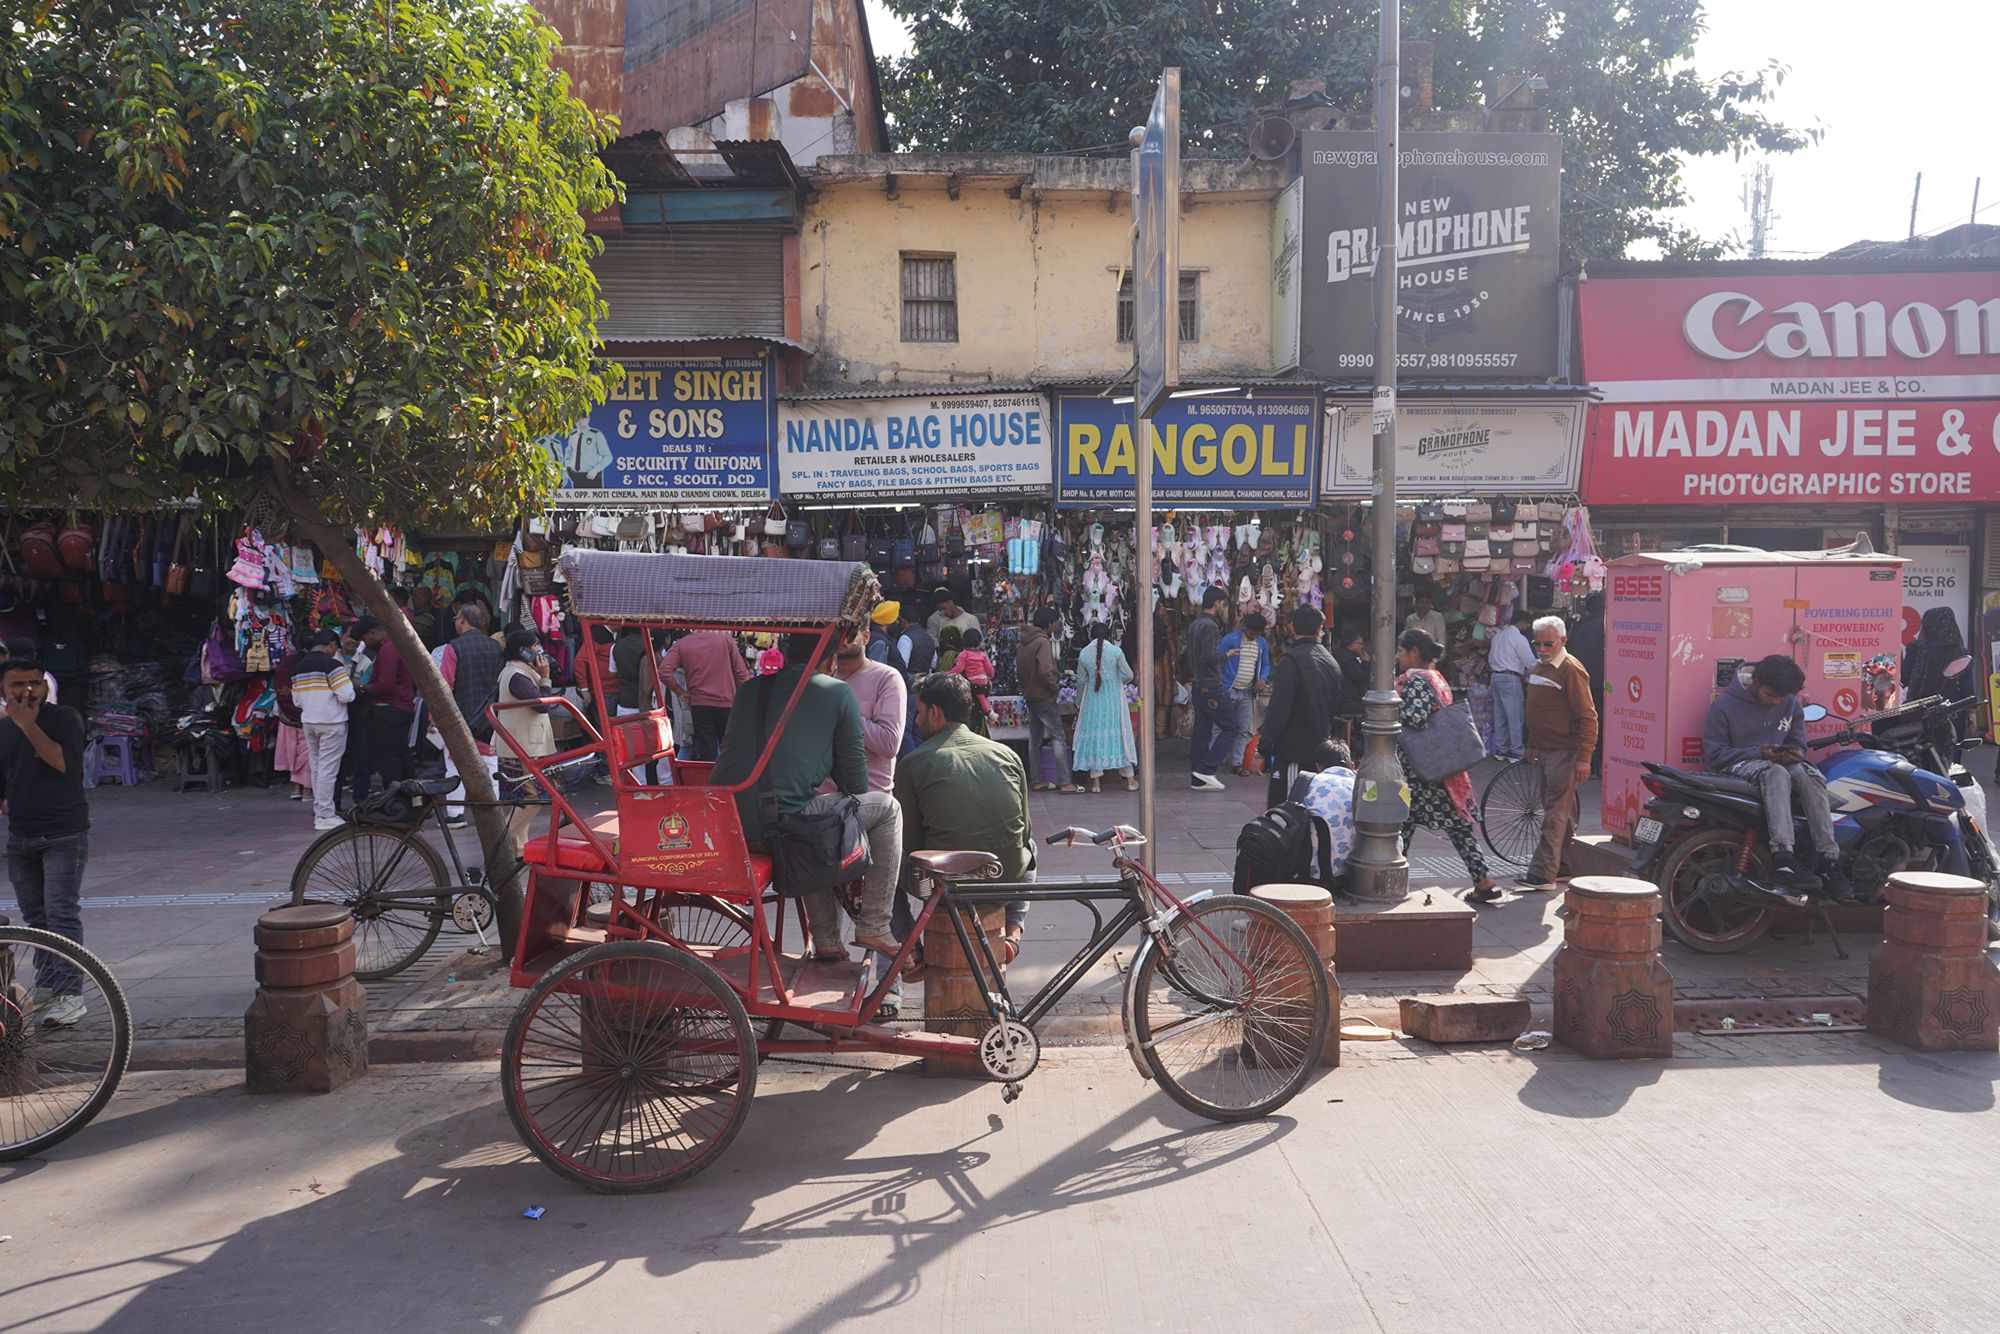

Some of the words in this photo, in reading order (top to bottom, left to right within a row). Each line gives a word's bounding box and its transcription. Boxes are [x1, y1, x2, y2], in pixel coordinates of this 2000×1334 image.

[1313, 149, 1548, 168] newgraphonehouse.com
[1405, 196, 1451, 216] NEW
[1400, 266, 1468, 289] HOUSE
[1396, 305, 1446, 323] SINCE
[1454, 290, 1489, 318] 1930
[1683, 291, 2000, 360] Canon
[609, 371, 662, 401] EET
[673, 370, 763, 402] SINGH
[1770, 381, 1835, 395] MADAN
[1840, 380, 1872, 394] JEE
[1877, 380, 1890, 394] &
[1895, 379, 1926, 393] CO.
[930, 401, 940, 410] M.
[1187, 405, 1197, 415] M.
[1200, 404, 1254, 416] 9650676704,
[1257, 405, 1310, 415] 8130964869
[617, 409, 637, 439] &
[649, 408, 725, 439] SONS
[786, 418, 879, 453] NANDA
[887, 415, 941, 450] BAG
[950, 412, 1041, 448] HOUSE
[1613, 409, 1800, 458] MADAN
[1819, 409, 1917, 458] JEE
[1936, 408, 1973, 458] &
[662, 444, 692, 454] DEALS
[696, 445, 705, 453] IN
[1068, 423, 1308, 476] RANGOLI
[1418, 429, 1491, 457] GRAMOPHONE
[616, 456, 688, 471] SECURITY
[694, 456, 762, 471] UNIFORM
[854, 456, 898, 466] RETAILER
[901, 455, 907, 464] &
[909, 453, 976, 464] WHOLESALERS
[791, 471, 811, 479] SPL.
[830, 469, 881, 477] TRAVELING
[882, 467, 909, 477] BAGS,
[911, 466, 948, 475] SCHOOL
[950, 465, 977, 475] BAGS,
[979, 463, 1014, 473] SPORTS
[1015, 462, 1040, 472] BAGS
[622, 475, 632, 485] &
[638, 475, 668, 487] NCC,
[673, 475, 722, 487] SCOUT,
[727, 474, 756, 485] DCD
[817, 481, 846, 489] FANCY
[848, 480, 875, 489] BAGS,
[877, 479, 897, 487] FILE
[899, 478, 923, 486] BAGS
[925, 477, 932, 485] &
[935, 476, 967, 485] PITTHU
[969, 475, 994, 484] BAGS
[996, 474, 1016, 483] ETC.
[1683, 472, 1882, 496] PHOTOGRAPHIC
[1889, 471, 1972, 495] STORE
[574, 490, 590, 498] OPP.
[592, 490, 609, 498] MOTI
[641, 490, 658, 498] MAIN
[660, 490, 679, 498] ROAD
[680, 490, 710, 498] CHANDNI
[741, 489, 767, 498] DELHI-6
[878, 490, 894, 498] NEAR
[896, 489, 914, 497] GAURI
[915, 488, 943, 497] SHANKAR
[971, 486, 997, 495] CHANDNI
[1062, 490, 1078, 498] SHOP
[1079, 490, 1088, 498] No.
[1109, 490, 1123, 498] MOTI
[1165, 490, 1183, 498] GAURI
[1184, 490, 1211, 498] SHANKAR
[1237, 490, 1262, 498] CHANDNI
[1286, 490, 1308, 498] DELHI-6
[1614, 575, 1662, 596] BSES
[1903, 575, 1933, 588] EOS
[1936, 575, 1956, 588] R6
[1907, 589, 1932, 597] Mark
[1934, 589, 1944, 597] III
[1804, 608, 1860, 618] POWERING
[1862, 608, 1893, 618] DELHI
[1813, 623, 1884, 633] EMPOWERING
[1616, 634, 1657, 646] EMPOWERING
[1816, 637, 1880, 647] CONSUMERS
[1618, 648, 1654, 660] CONSUMERS
